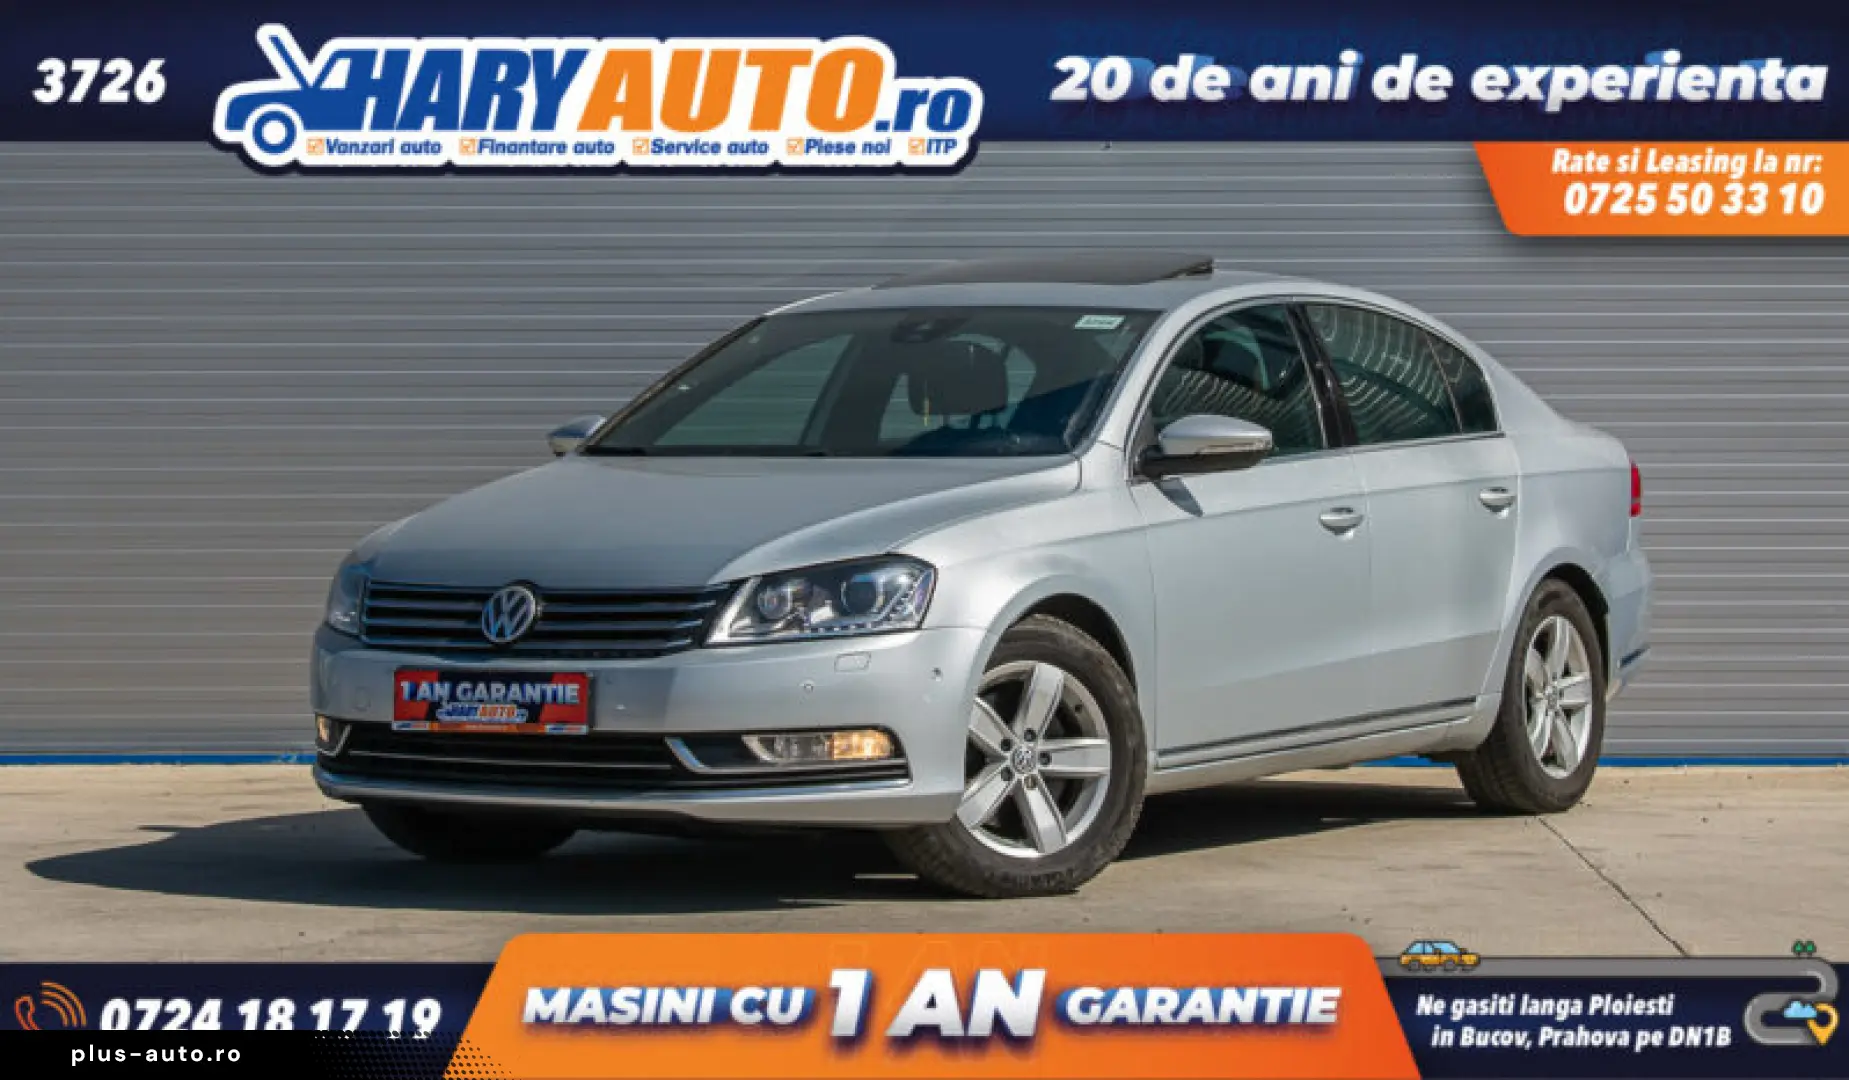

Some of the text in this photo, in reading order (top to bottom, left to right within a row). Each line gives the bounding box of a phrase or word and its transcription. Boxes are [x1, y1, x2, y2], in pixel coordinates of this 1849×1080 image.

[400, 681, 580, 705] 1 AN GARANTIE
